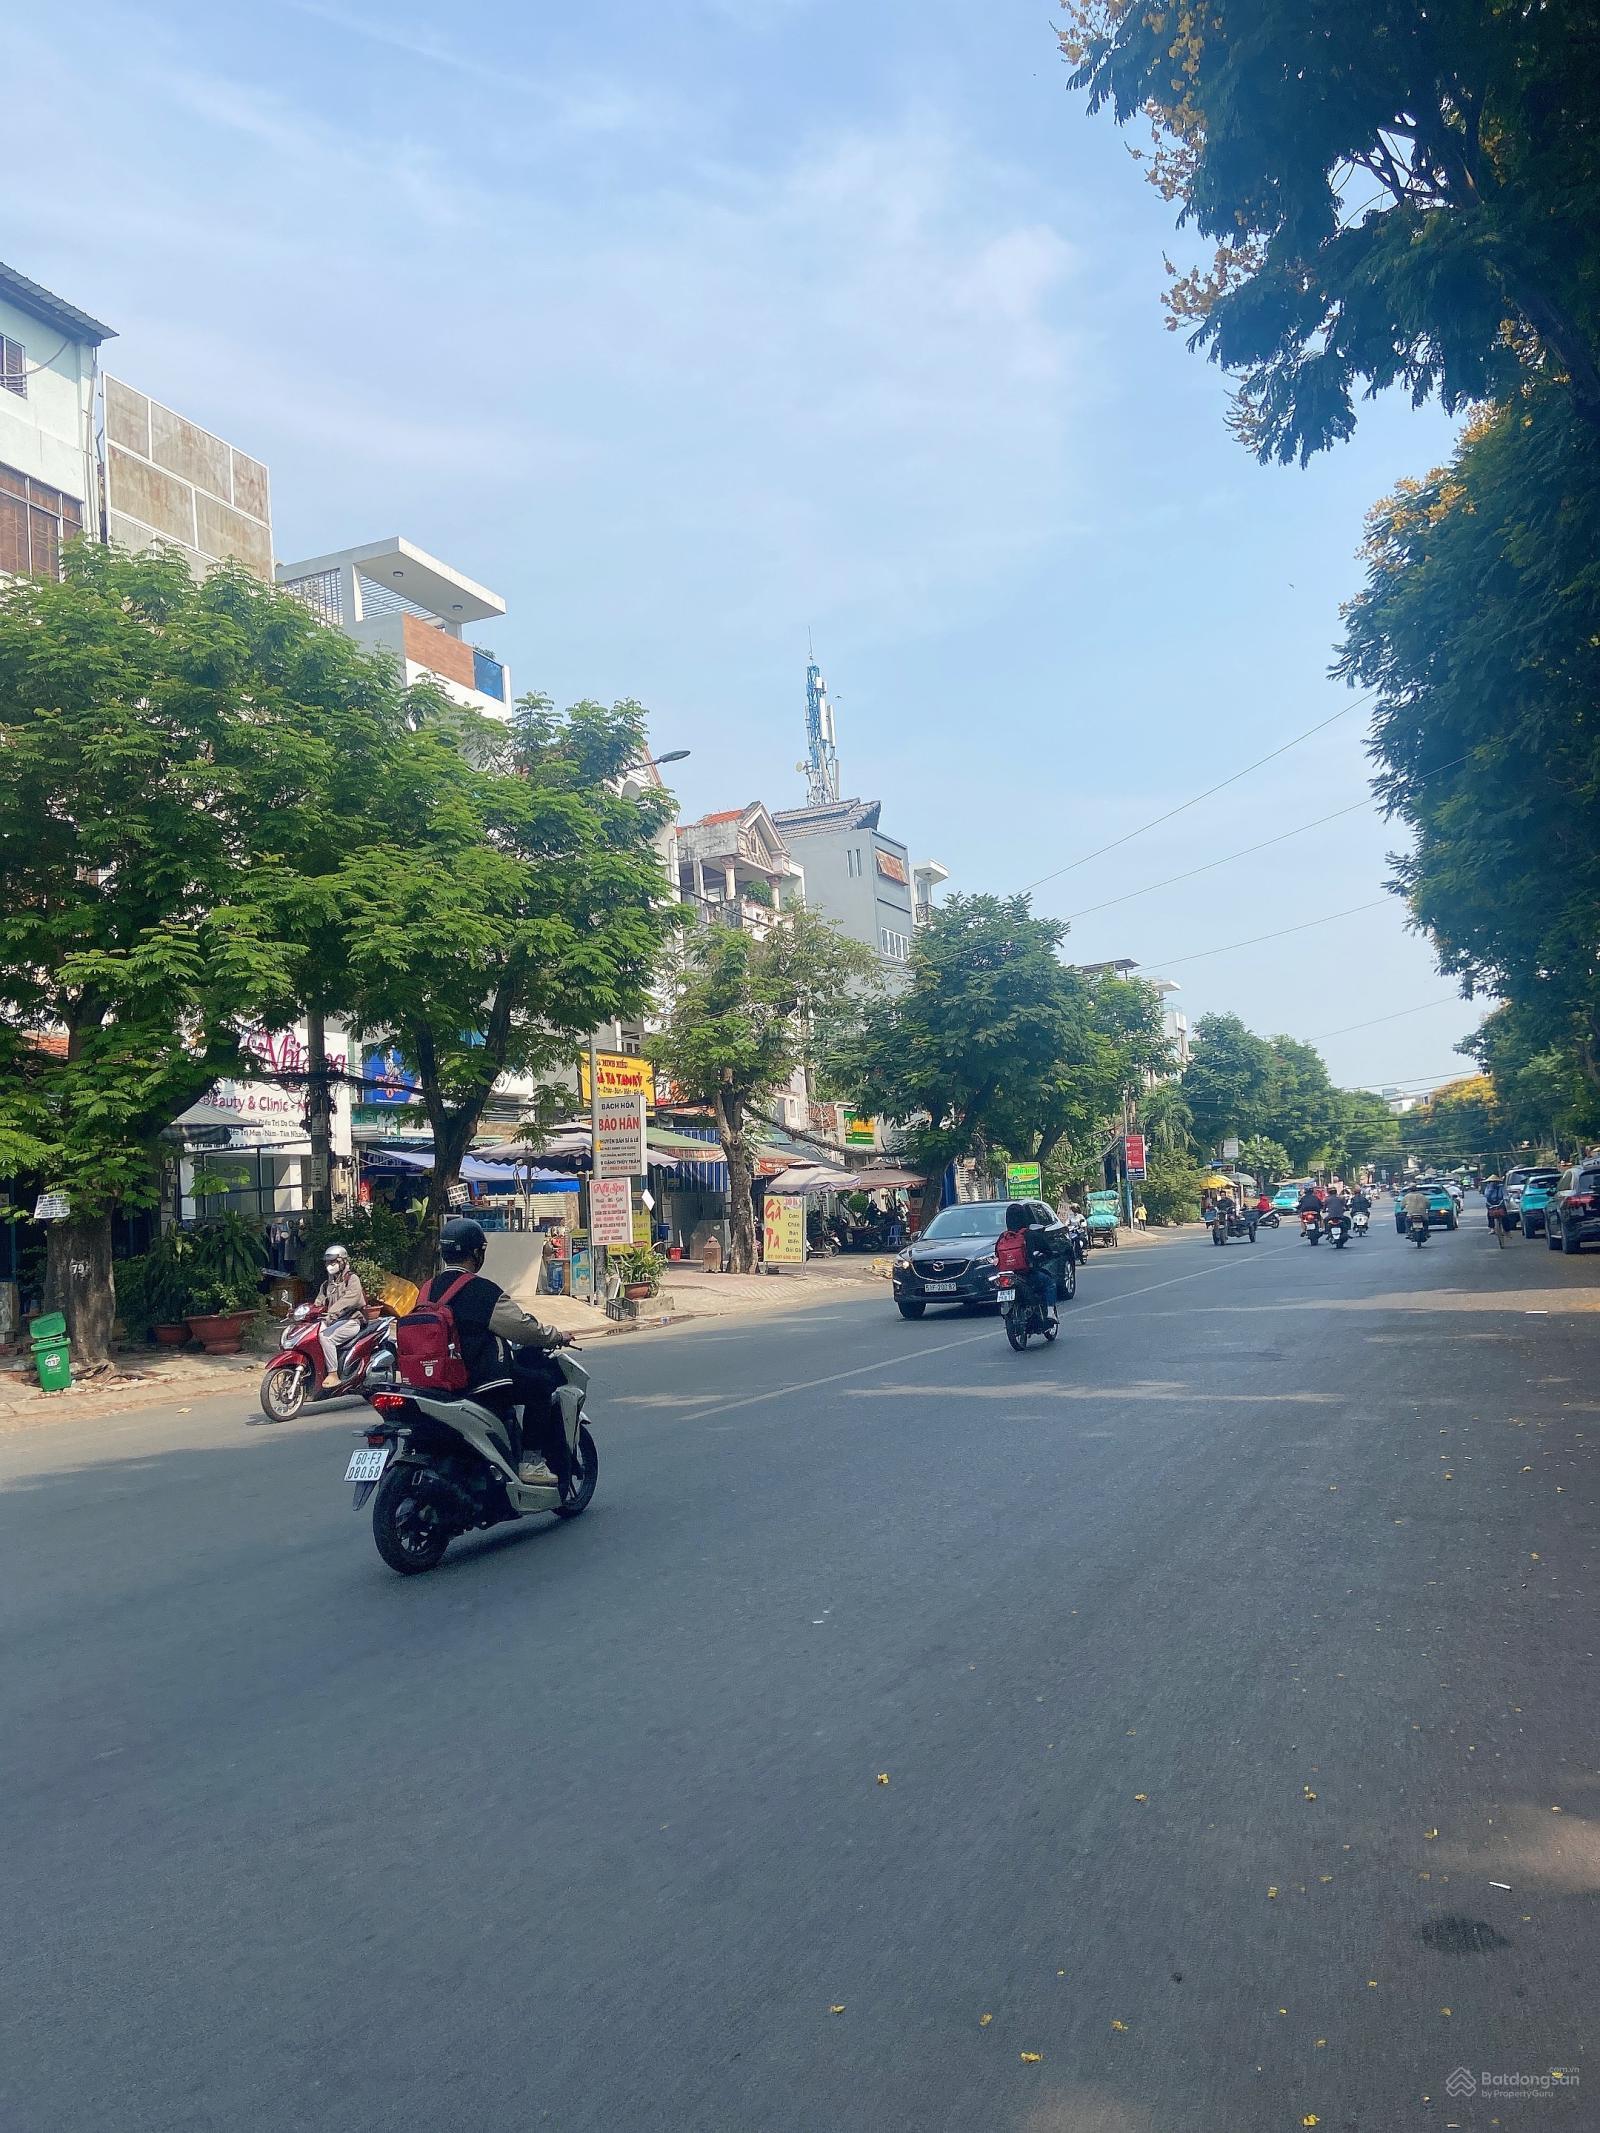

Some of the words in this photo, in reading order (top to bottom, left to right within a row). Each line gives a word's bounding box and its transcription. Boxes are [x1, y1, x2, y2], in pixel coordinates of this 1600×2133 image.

[248, 1096, 256, 1110] &
[259, 1096, 289, 1112] Clinic
[601, 1101, 620, 1110] BÁCH
[620, 1100, 635, 1109] HÓA
[599, 1114, 618, 1131] BẢO
[619, 1114, 640, 1130] HÂN
[609, 1183, 625, 1195] Spa
[356, 1452, 383, 1465] 60-F3
[347, 1466, 381, 1479] 080.68
